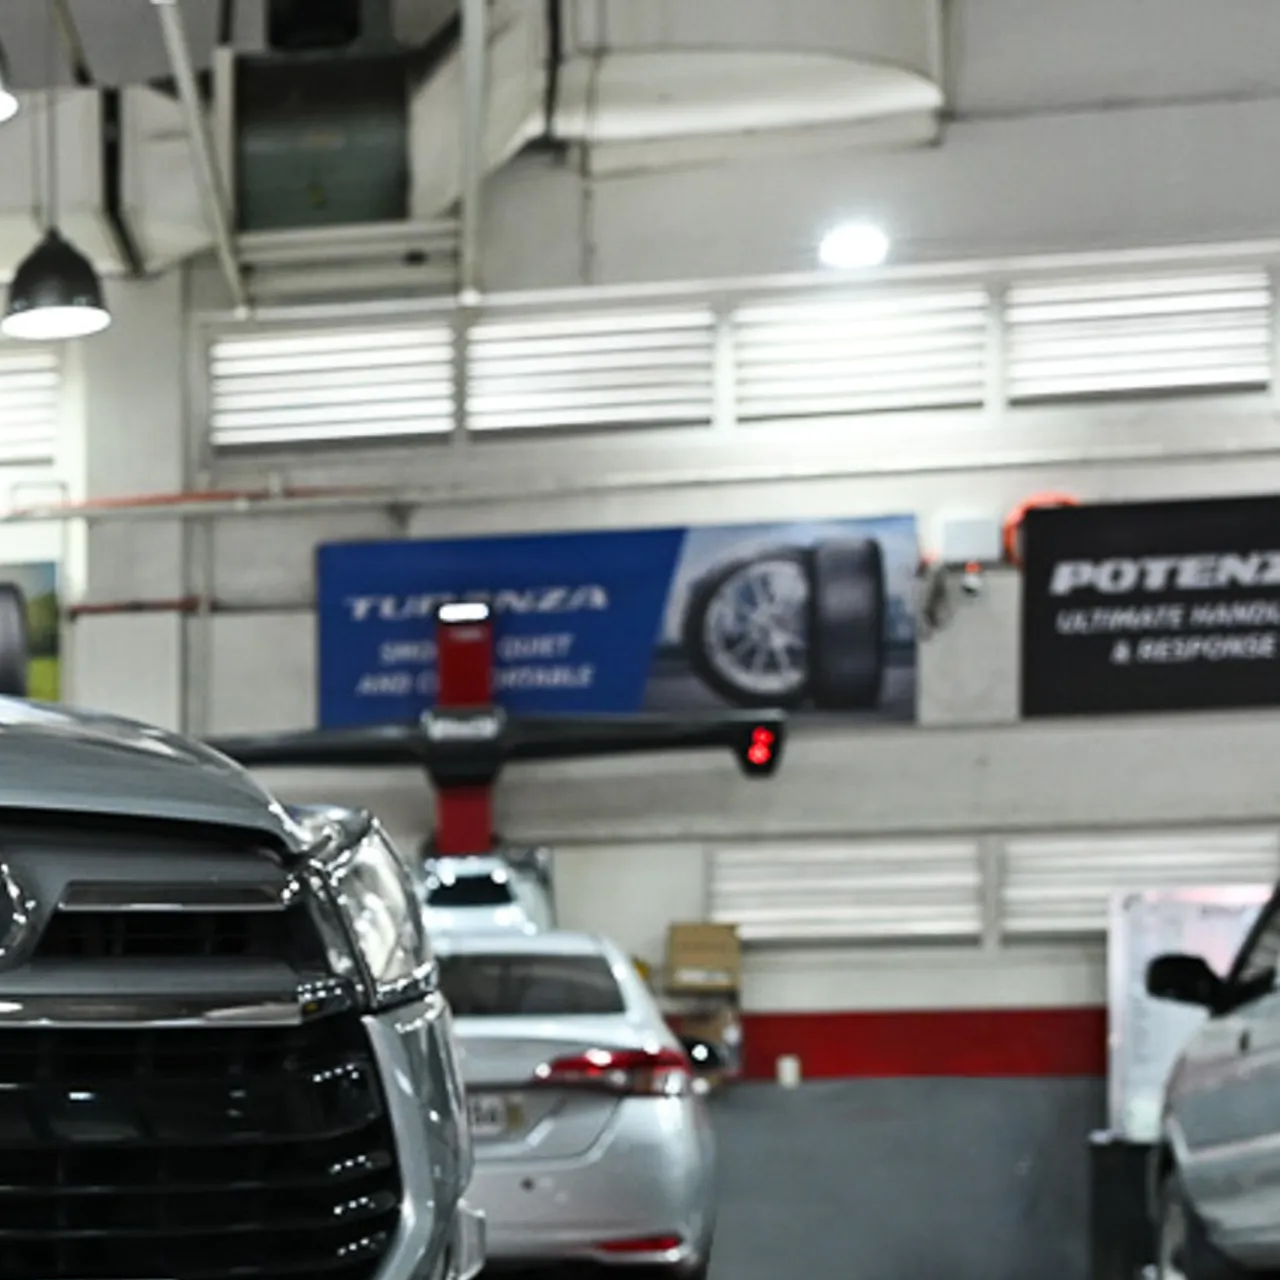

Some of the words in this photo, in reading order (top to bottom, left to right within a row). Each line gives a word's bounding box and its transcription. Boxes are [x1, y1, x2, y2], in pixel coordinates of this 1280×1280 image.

[1056, 606, 1183, 633] ULTIMATE
[1138, 633, 1277, 662] RESPONSE
[357, 671, 413, 695] AND
